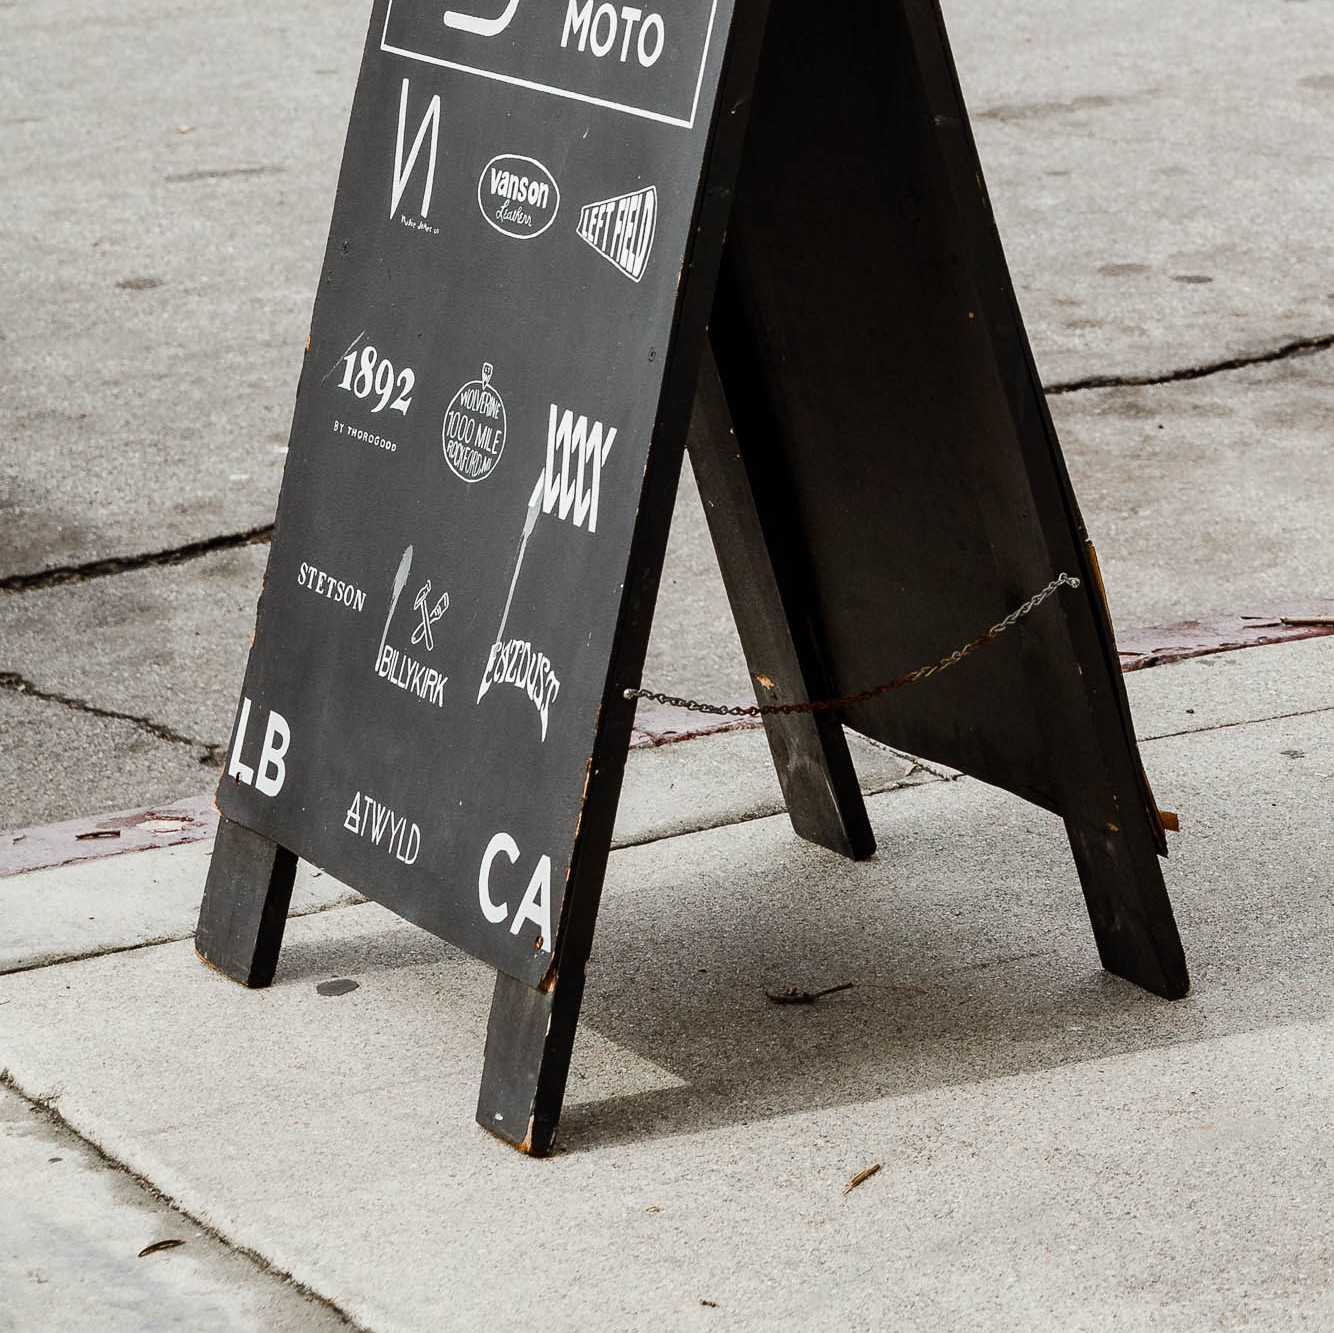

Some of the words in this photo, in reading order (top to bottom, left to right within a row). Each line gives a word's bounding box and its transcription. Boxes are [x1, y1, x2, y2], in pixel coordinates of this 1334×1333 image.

[581, 201, 616, 252] LEFT
[609, 189, 655, 278] FIELD
[337, 345, 416, 416] 1892
[460, 388, 501, 420] WOLVERINE
[333, 420, 345, 434] BY
[347, 425, 397, 452] THOROGOOD
[446, 410, 476, 445] 1000
[474, 423, 503, 454] MILE
[297, 561, 368, 612] STETSON
[378, 644, 449, 708] BILLYKIRK
[228, 697, 291, 797] LB
[343, 790, 421, 864] ATWYLD
[478, 832, 552, 953] CA
